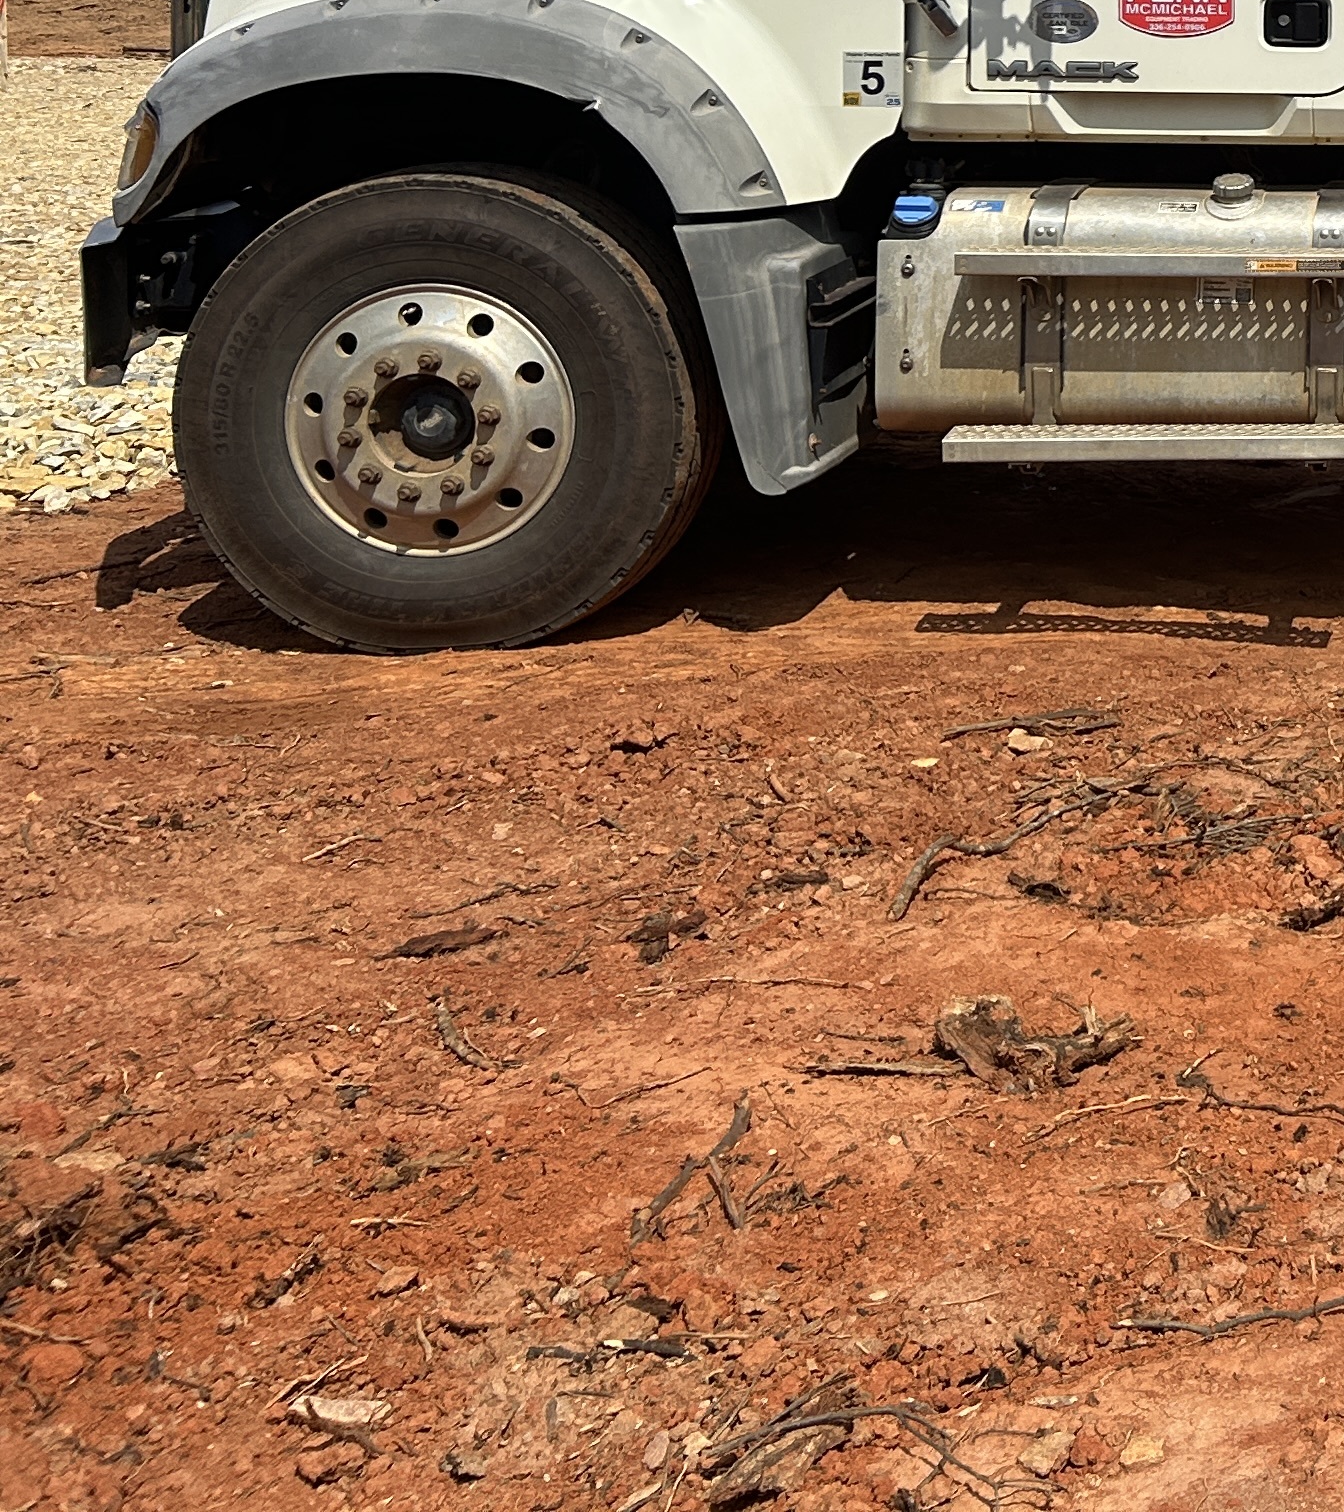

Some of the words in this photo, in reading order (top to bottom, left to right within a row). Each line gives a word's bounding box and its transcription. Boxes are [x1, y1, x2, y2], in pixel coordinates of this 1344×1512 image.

[1125, 3, 1228, 16] MCMICHAEL
[860, 60, 886, 96] 5
[986, 59, 1139, 80] MACK
[357, 219, 597, 307] GENERAL
[227, 311, 260, 361] 22.5
[219, 361, 238, 378] R
[211, 381, 231, 457] 315/80
